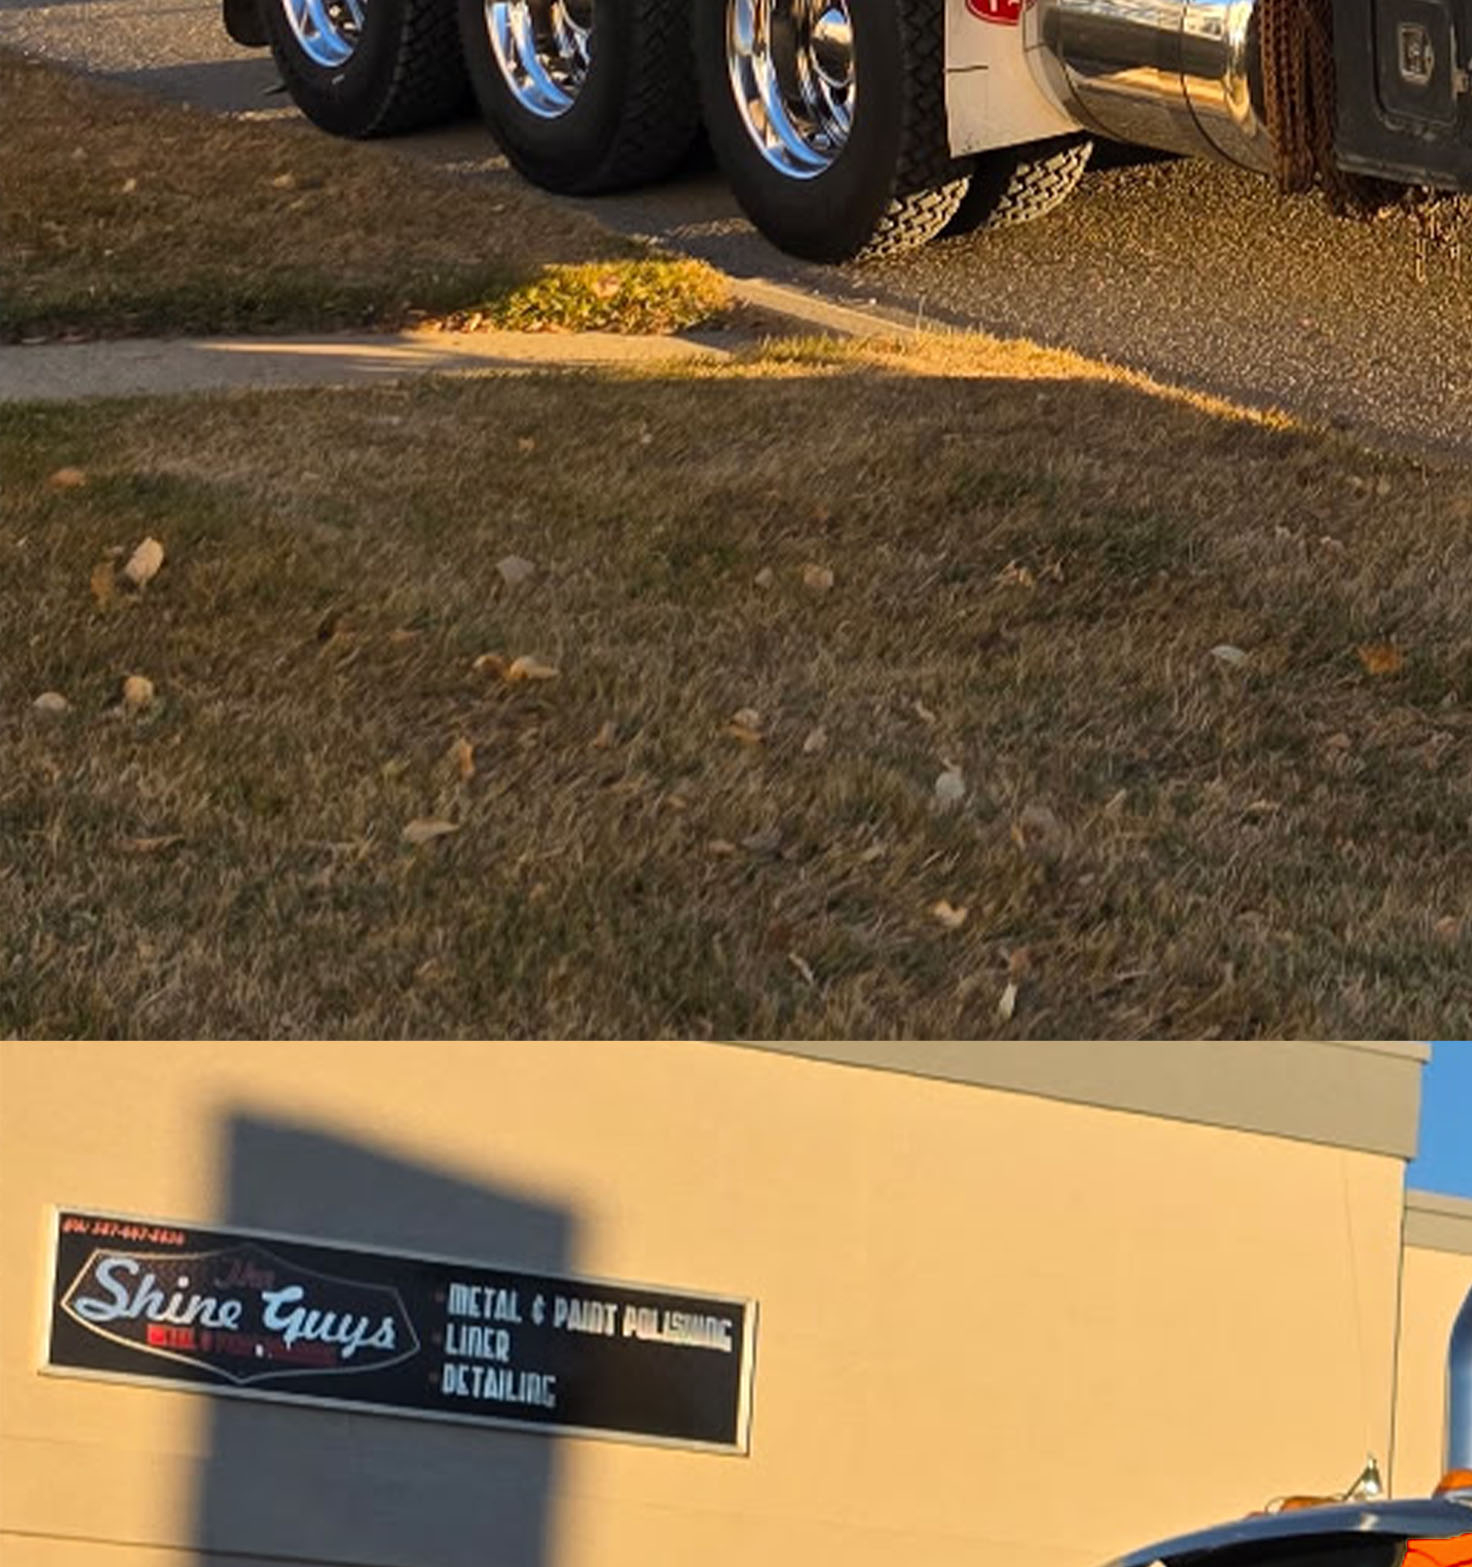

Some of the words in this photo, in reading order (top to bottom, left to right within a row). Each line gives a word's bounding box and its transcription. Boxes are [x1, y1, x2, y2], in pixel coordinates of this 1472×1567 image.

[73, 1256, 243, 1331] Shine
[261, 1285, 396, 1359] Guys
[447, 1282, 523, 1323] METAL
[531, 1293, 547, 1326] &
[553, 1295, 619, 1336] PAINT
[622, 1303, 734, 1353] POLISHING
[444, 1322, 511, 1363] LINER
[441, 1362, 557, 1409] DETAILING
